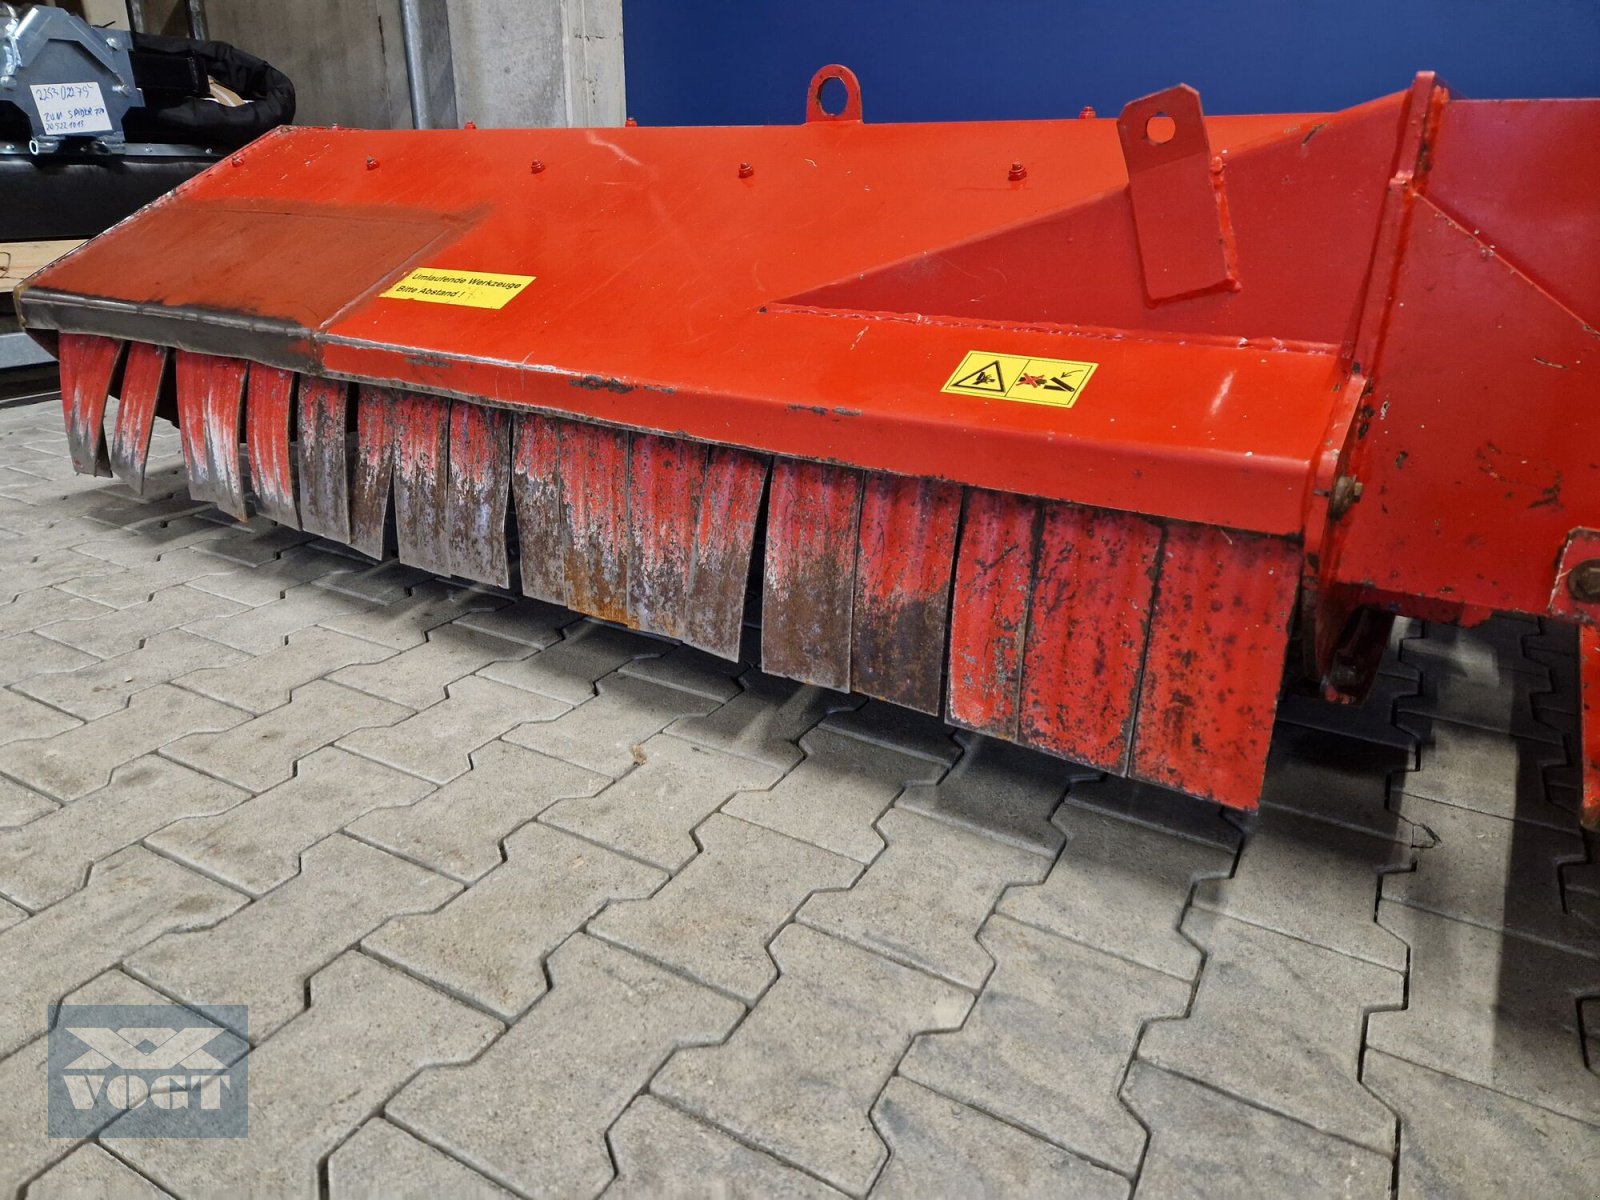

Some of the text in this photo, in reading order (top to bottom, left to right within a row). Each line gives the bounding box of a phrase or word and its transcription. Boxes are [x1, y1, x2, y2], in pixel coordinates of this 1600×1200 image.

[412, 273, 522, 290] Umlaufende Werkzeuge
[395, 285, 418, 294] Bitte
[419, 287, 458, 298] Abstand
